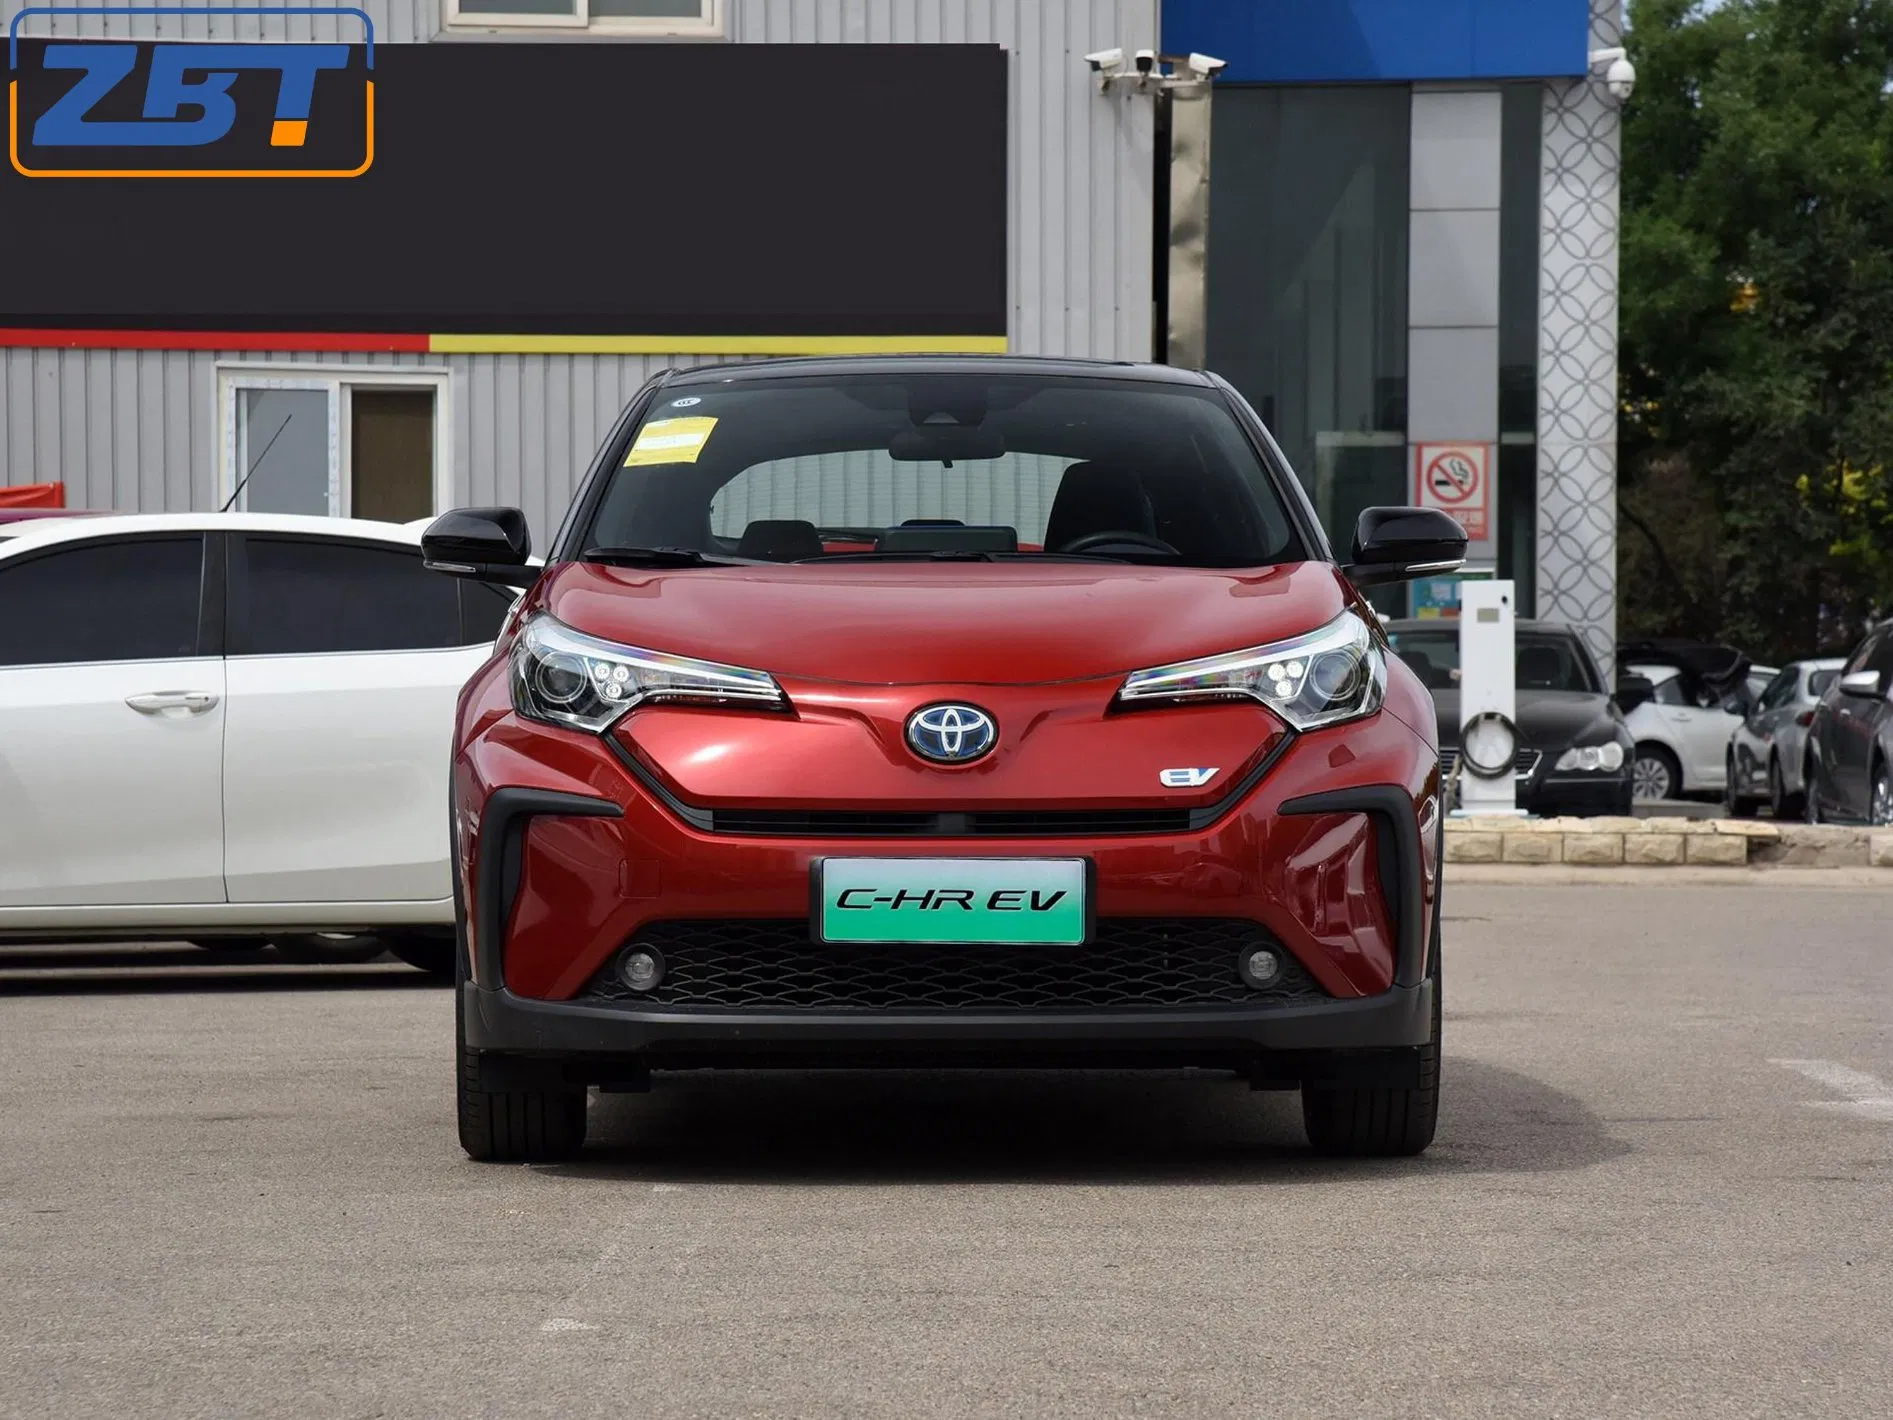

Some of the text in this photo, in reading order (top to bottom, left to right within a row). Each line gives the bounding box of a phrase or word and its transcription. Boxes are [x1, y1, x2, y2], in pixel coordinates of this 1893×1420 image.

[1159, 767, 1220, 787] EV
[836, 888, 1067, 911] C-HR EV
